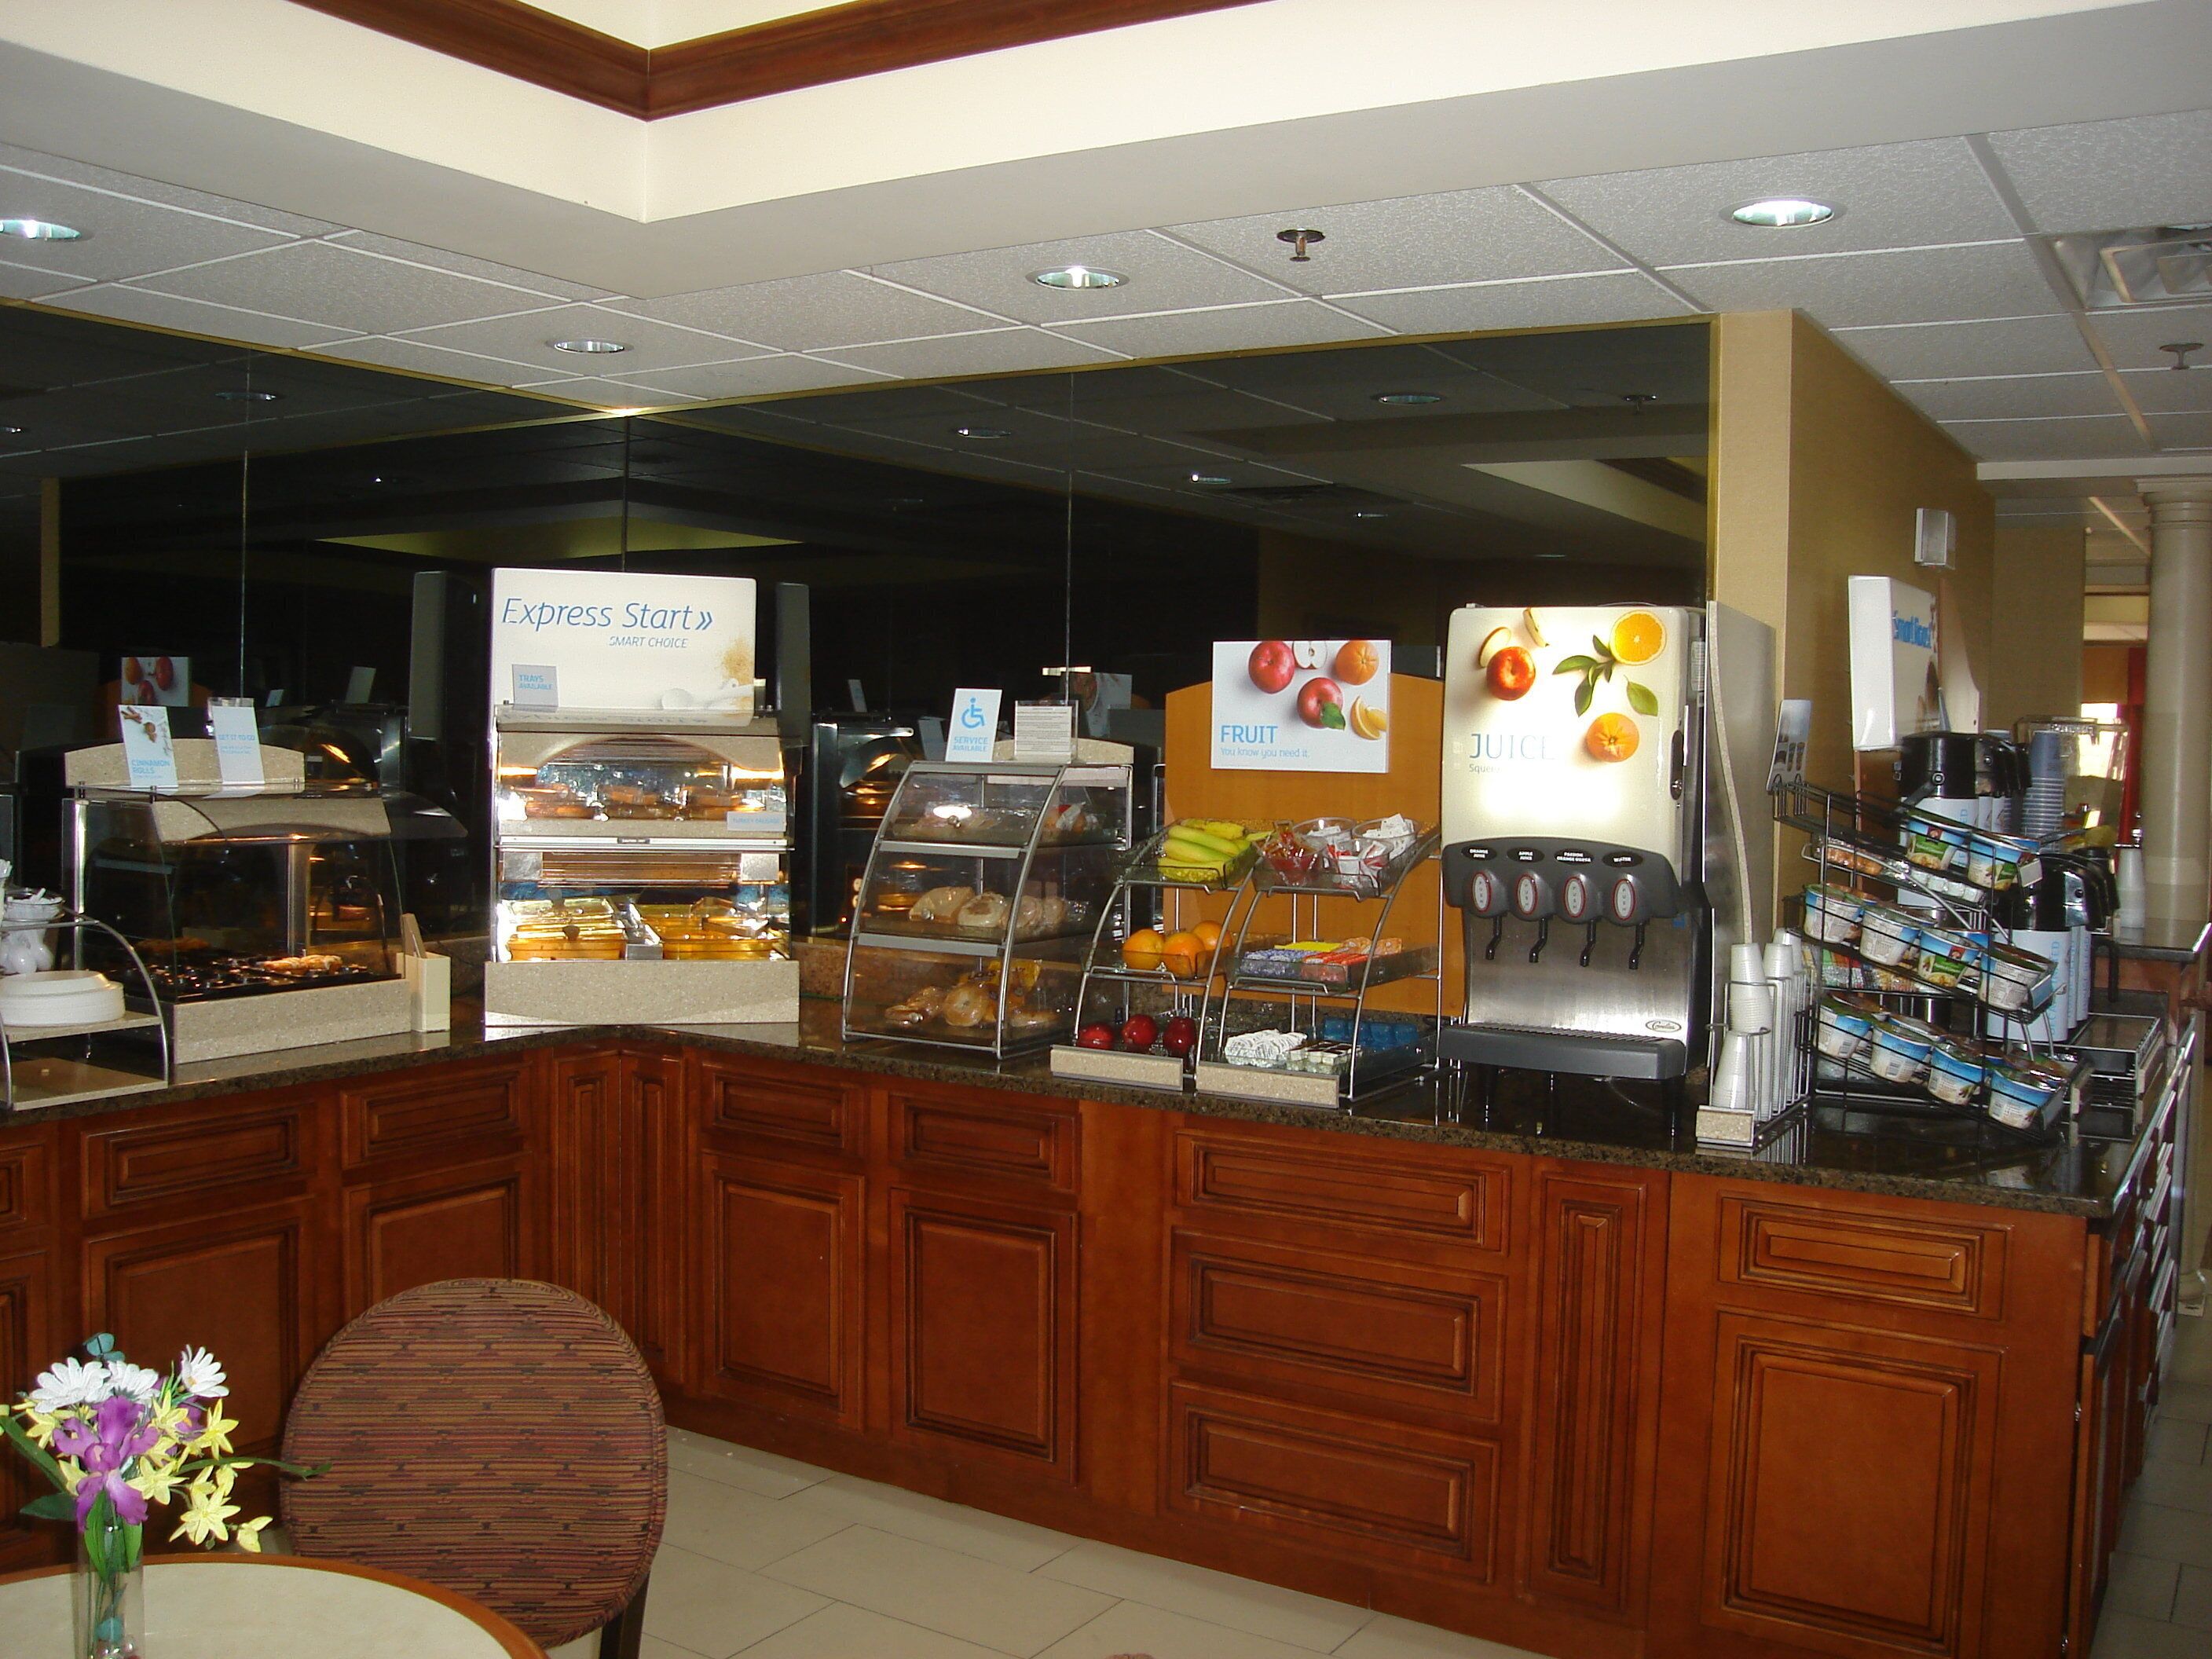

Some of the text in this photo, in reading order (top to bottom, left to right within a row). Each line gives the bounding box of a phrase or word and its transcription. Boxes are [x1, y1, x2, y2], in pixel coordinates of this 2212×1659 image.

[501, 598, 613, 632] Express
[609, 635, 688, 648] SMART CHOICE
[518, 673, 544, 682] TRAYS
[1221, 725, 1278, 743] FRUIT
[1262, 749, 1277, 759] you
[1280, 749, 1300, 757] need
[1469, 733, 1555, 760] JUICE
